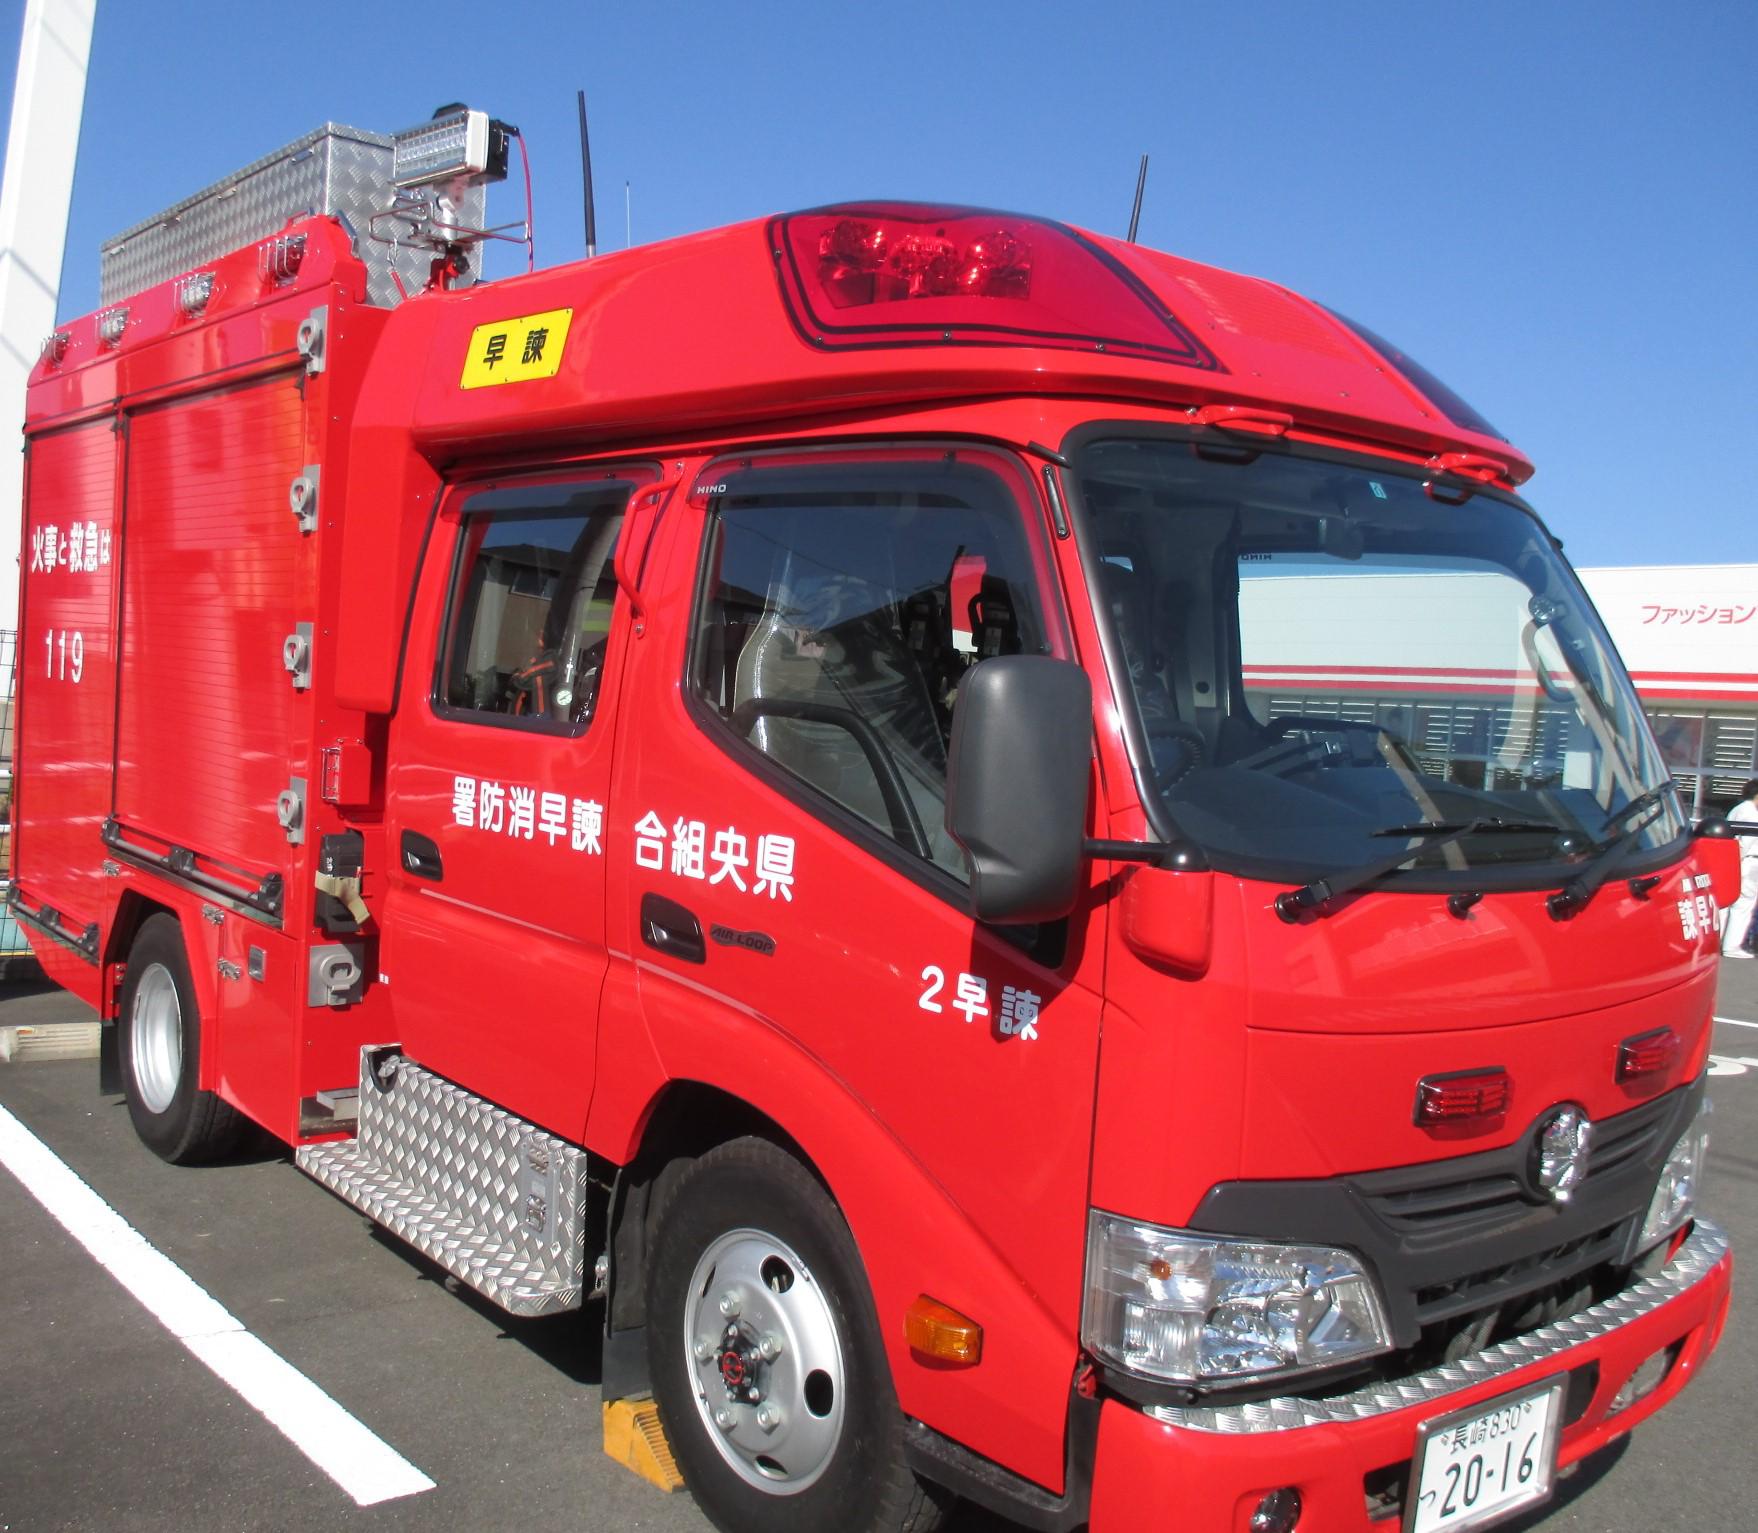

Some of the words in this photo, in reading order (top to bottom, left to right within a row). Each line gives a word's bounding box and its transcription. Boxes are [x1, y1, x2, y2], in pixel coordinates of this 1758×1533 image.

[696, 484, 727, 494] HINO
[31, 520, 112, 573] 火事と救急は
[1641, 604, 1757, 625] ファッション
[45, 629, 84, 683] 119
[633, 810, 796, 903] 合組央県
[711, 927, 734, 940] AIR
[737, 934, 773, 951] LOOP
[1439, 1431, 1538, 1519] 20-16
